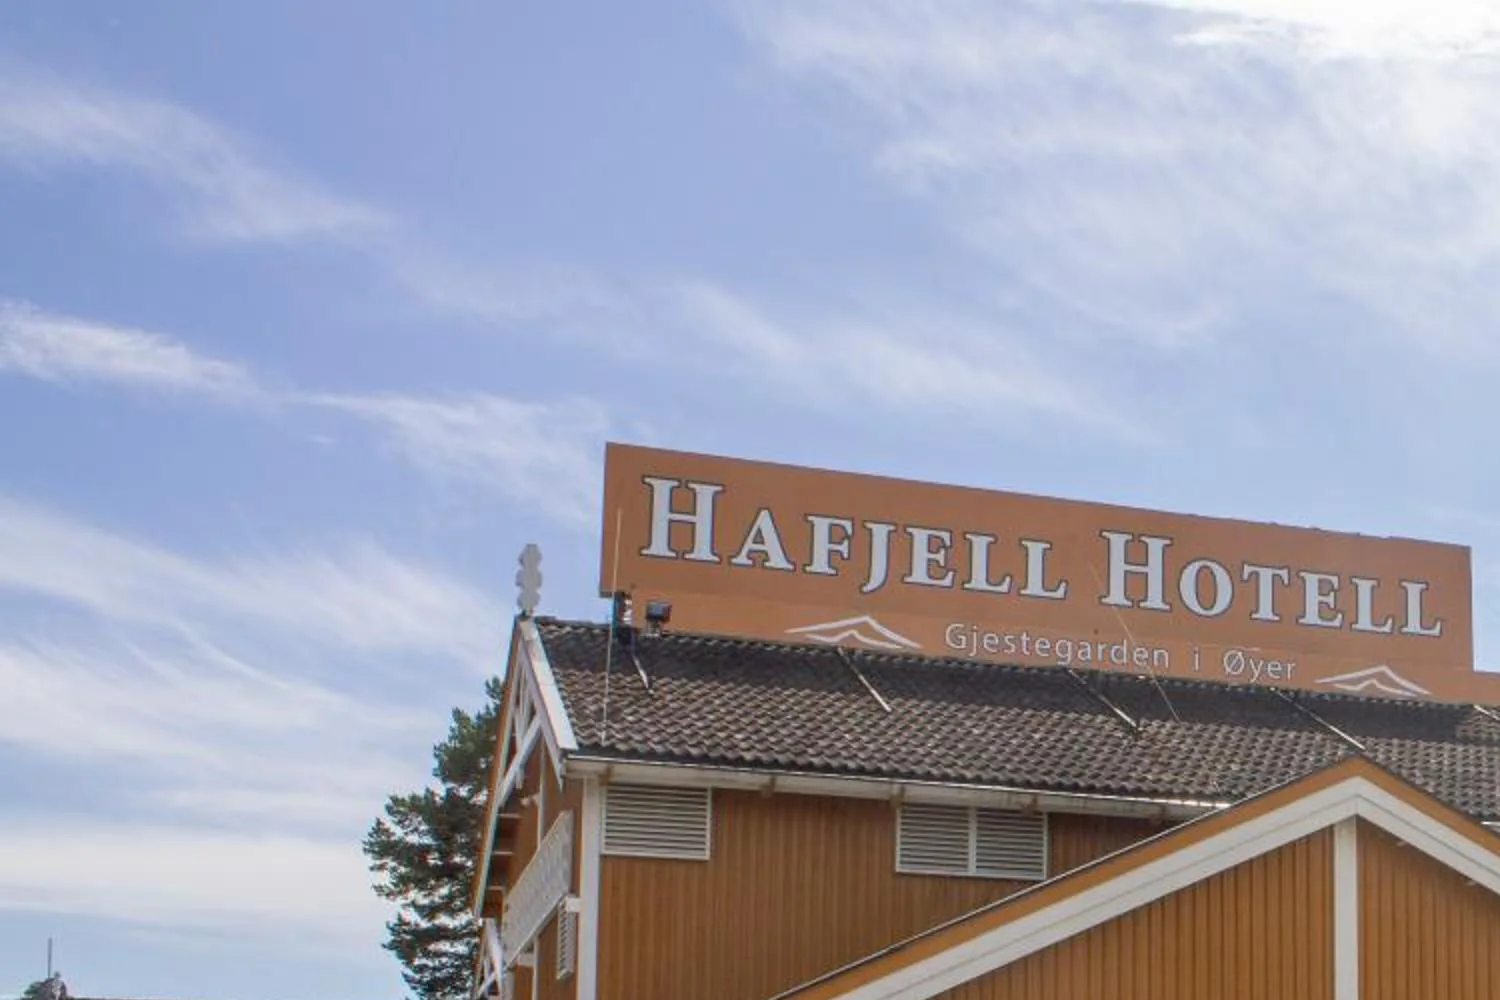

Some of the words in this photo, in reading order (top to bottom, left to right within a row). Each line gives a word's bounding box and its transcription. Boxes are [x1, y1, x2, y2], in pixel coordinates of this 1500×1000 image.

[640, 475, 1068, 602] HAFJELL
[1100, 530, 1442, 637] HOTELL
[945, 623, 1169, 668] Gjestegarden
[1223, 649, 1295, 681] Øyer
